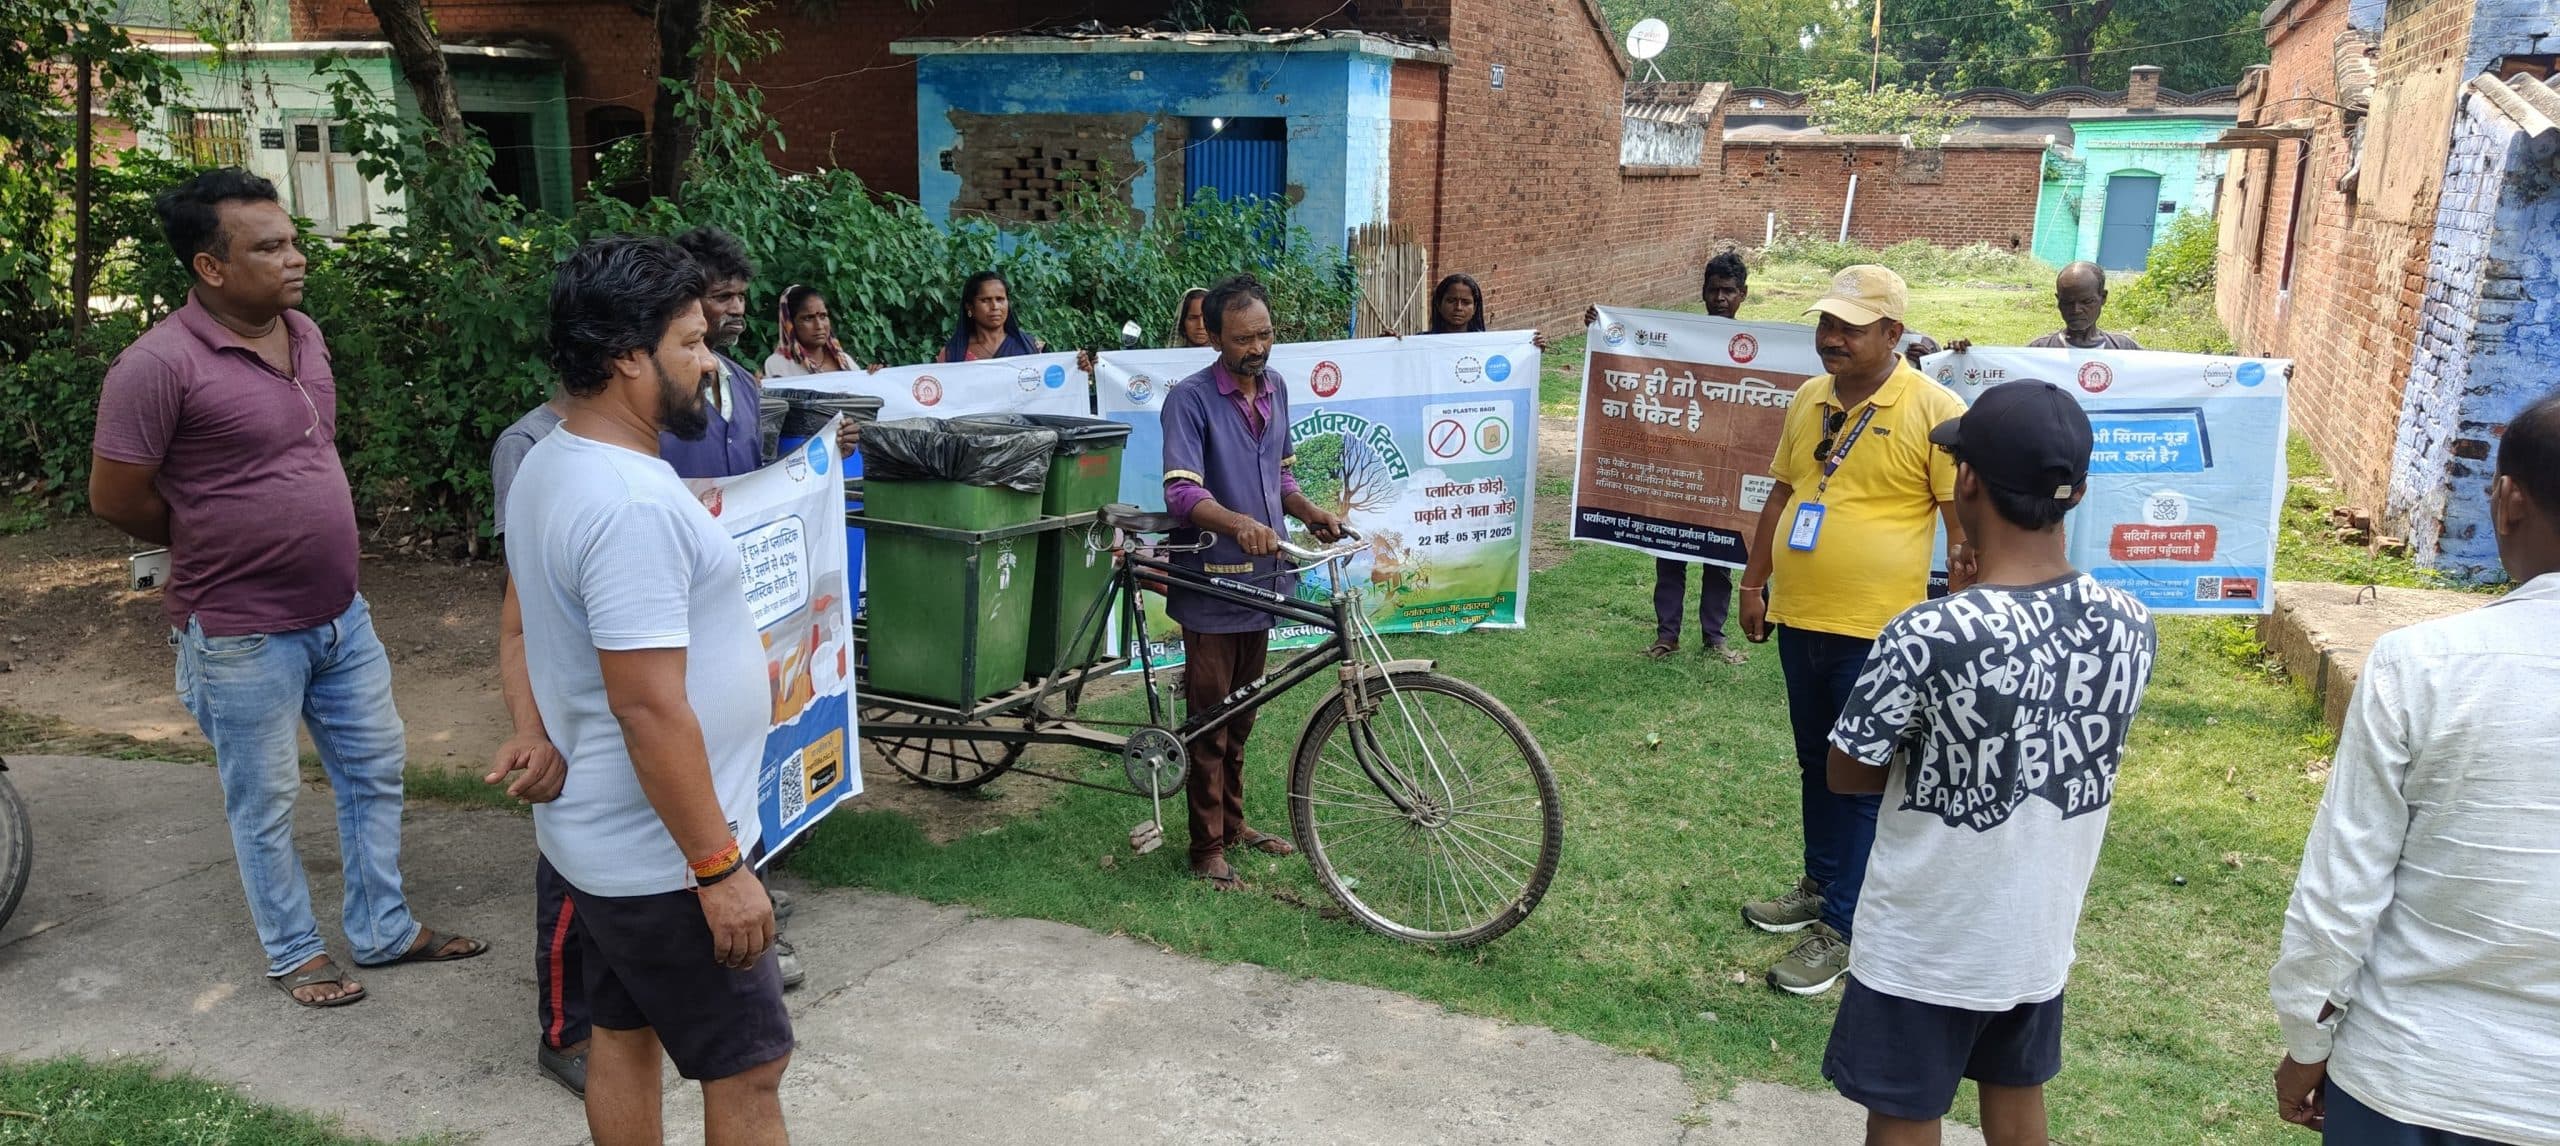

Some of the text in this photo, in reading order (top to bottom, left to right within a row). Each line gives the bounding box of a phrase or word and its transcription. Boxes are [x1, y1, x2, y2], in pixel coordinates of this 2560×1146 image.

[1650, 331, 1669, 341] LiFE
[1604, 367, 1798, 409] एक ही तो प्लास्टिक
[1983, 369, 2006, 379] LiFE
[1602, 394, 1704, 433] का पैकेट है
[1290, 407, 1410, 481] पर्यावरण दिवस
[2125, 446, 2156, 463] करते
[1425, 481, 1476, 499] प्लास्टिक
[1621, 471, 1634, 480] 1.4
[1414, 505, 1448, 526] प्रकृति
[1451, 504, 1462, 520] से
[1466, 504, 1490, 518] नाता
[770, 527, 799, 550] प्लास्टिक
[1418, 535, 1432, 547] 22
[1434, 531, 1450, 545] मई
[1456, 532, 1468, 543] 05
[1471, 529, 1487, 544] जून
[1489, 526, 1513, 539] 2025
[2151, 531, 2168, 541] तक
[2193, 528, 2206, 541] को
[779, 550, 798, 568] 43%
[1983, 600, 2055, 655] BAD
[2029, 605, 2108, 673] NEWS
[1999, 655, 2057, 701] BAD
[2064, 651, 2152, 714] BAR
[1918, 736, 2003, 790] BAR
[2020, 713, 2111, 791] BAD
[1948, 783, 1997, 818] BAD
[1971, 788, 2024, 829] NEWS
[2066, 773, 2118, 814] BAR
